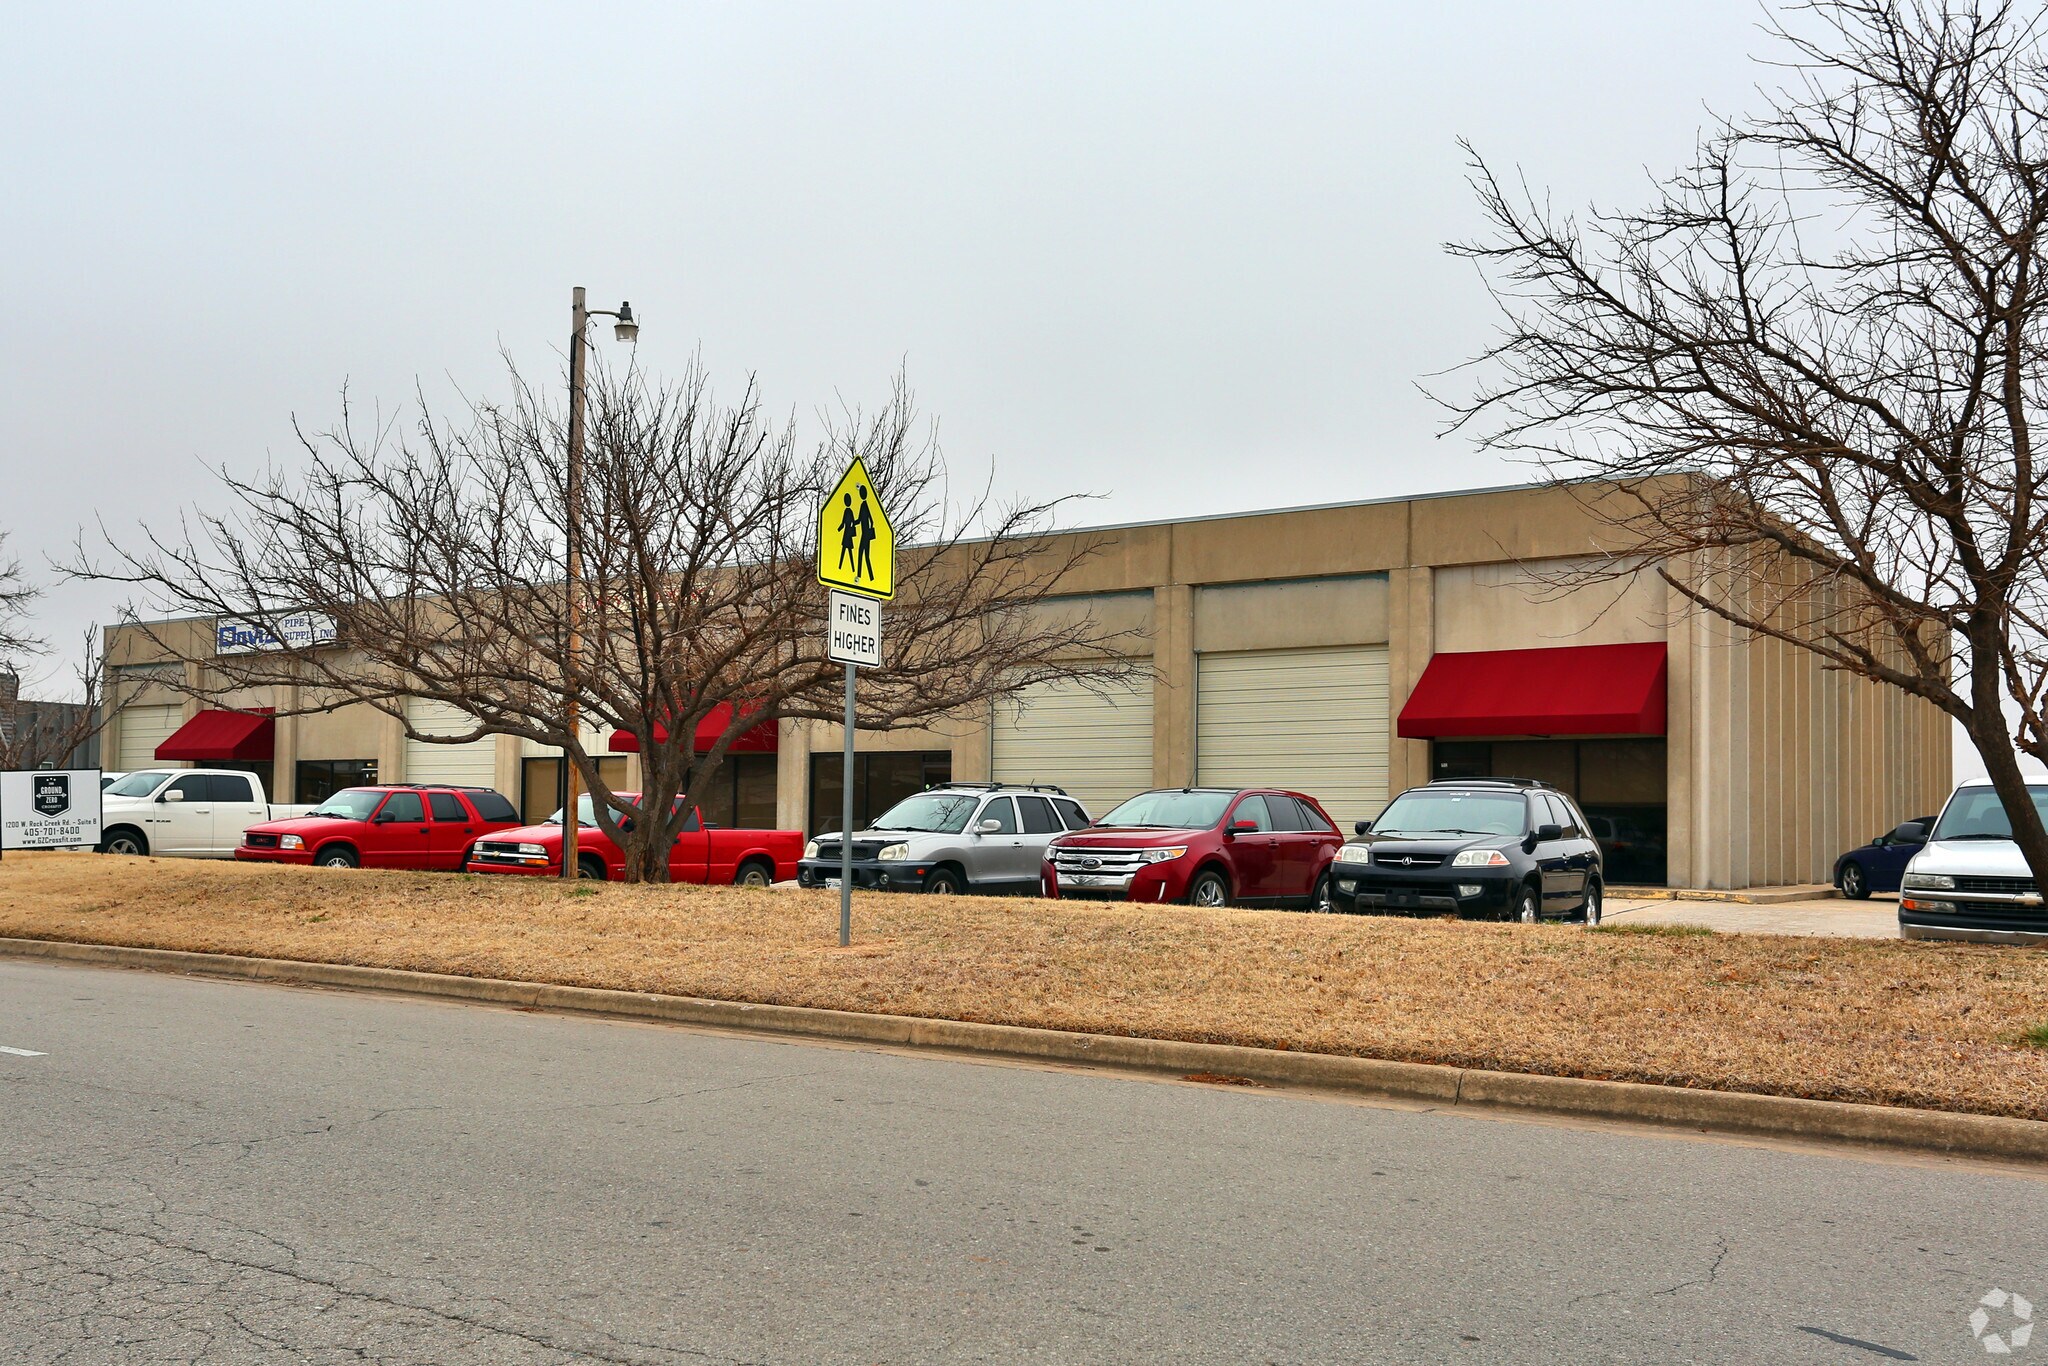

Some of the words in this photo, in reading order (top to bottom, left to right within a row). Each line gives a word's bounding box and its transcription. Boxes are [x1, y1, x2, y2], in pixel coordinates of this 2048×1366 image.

[839, 603, 871, 625] FINES
[284, 618, 305, 628] PIPE
[834, 630, 875, 654] HIGHER
[41, 786, 63, 795] GROUND
[46, 796, 58, 804] ZERO
[44, 819, 60, 827] Creek
[77, 818, 92, 826] Suite
[24, 826, 80, 837] 405-701-8400
[22, 836, 82, 845] www.GZCrossfit.com
